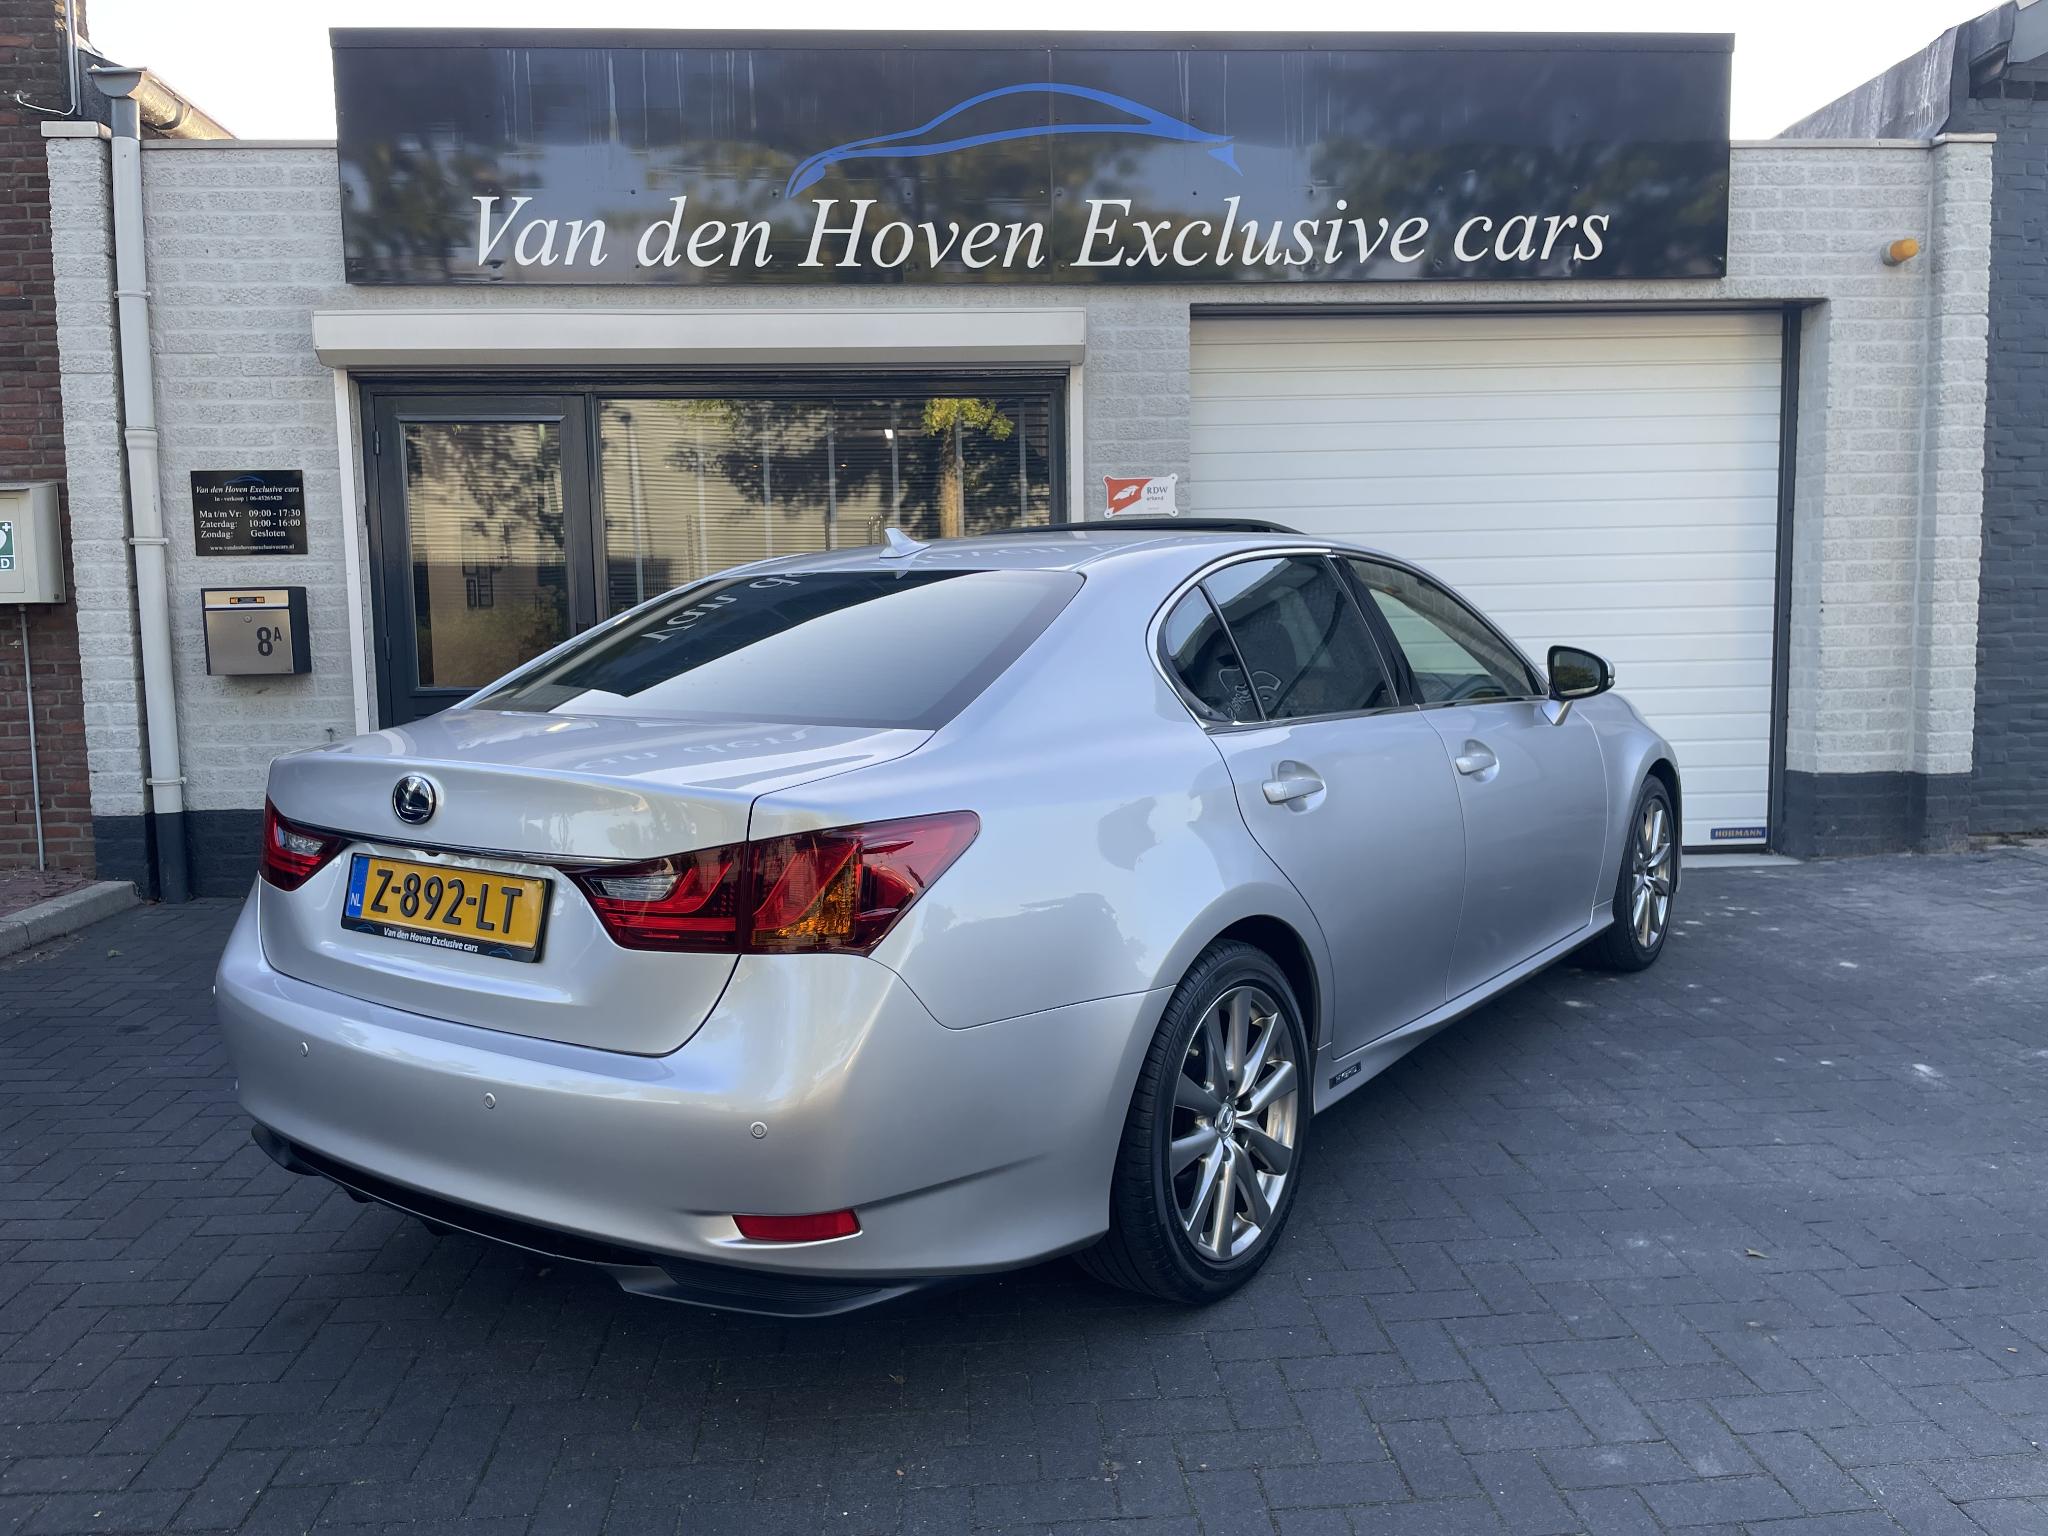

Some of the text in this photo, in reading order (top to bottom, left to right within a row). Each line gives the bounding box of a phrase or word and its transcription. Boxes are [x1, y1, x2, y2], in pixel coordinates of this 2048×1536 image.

[472, 195, 1610, 269] Van den Hoven Exclusive cars
[196, 486, 209, 494] Van
[249, 485, 283, 493] Exclusive
[1146, 486, 1168, 495] RDW
[199, 510, 213, 518] Ma
[228, 510, 242, 518] Vr:
[248, 509, 272, 517] 09:00
[278, 509, 301, 517] 17:30
[200, 520, 238, 529] Zaterdag:
[249, 519, 272, 528] 10:00
[278, 519, 301, 527] 16:00
[201, 529, 286, 540] Zondag: Gesloten
[350, 892, 361, 907] NL
[370, 868, 523, 935] Z-892-LT
[383, 926, 479, 953] Van den Hoven Exclusive cars
